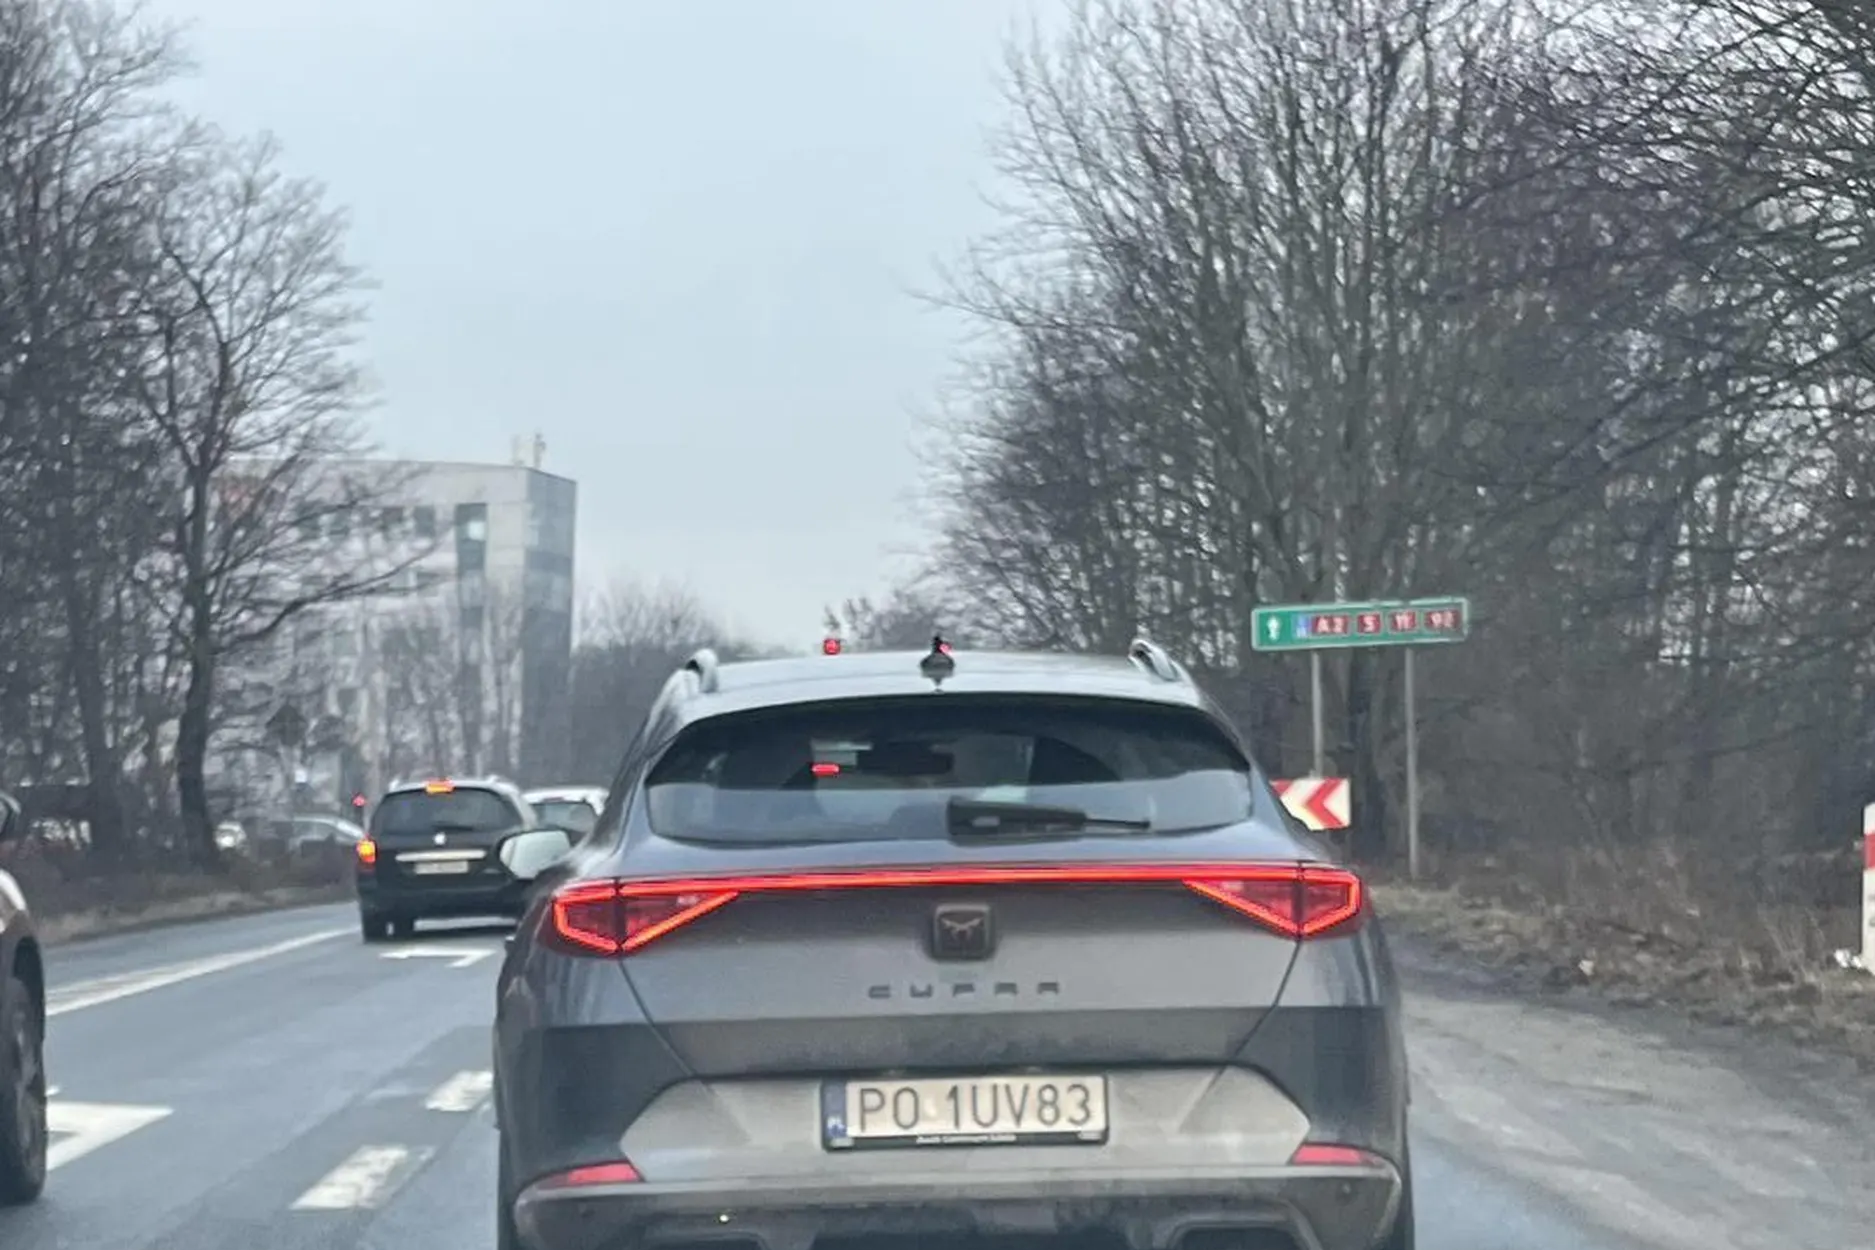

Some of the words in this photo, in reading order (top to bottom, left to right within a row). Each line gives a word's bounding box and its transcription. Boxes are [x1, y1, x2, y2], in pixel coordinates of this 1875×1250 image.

[868, 982, 1060, 999] CUPRA
[859, 1086, 919, 1132] PO
[945, 1082, 1091, 1130] 1UV83
